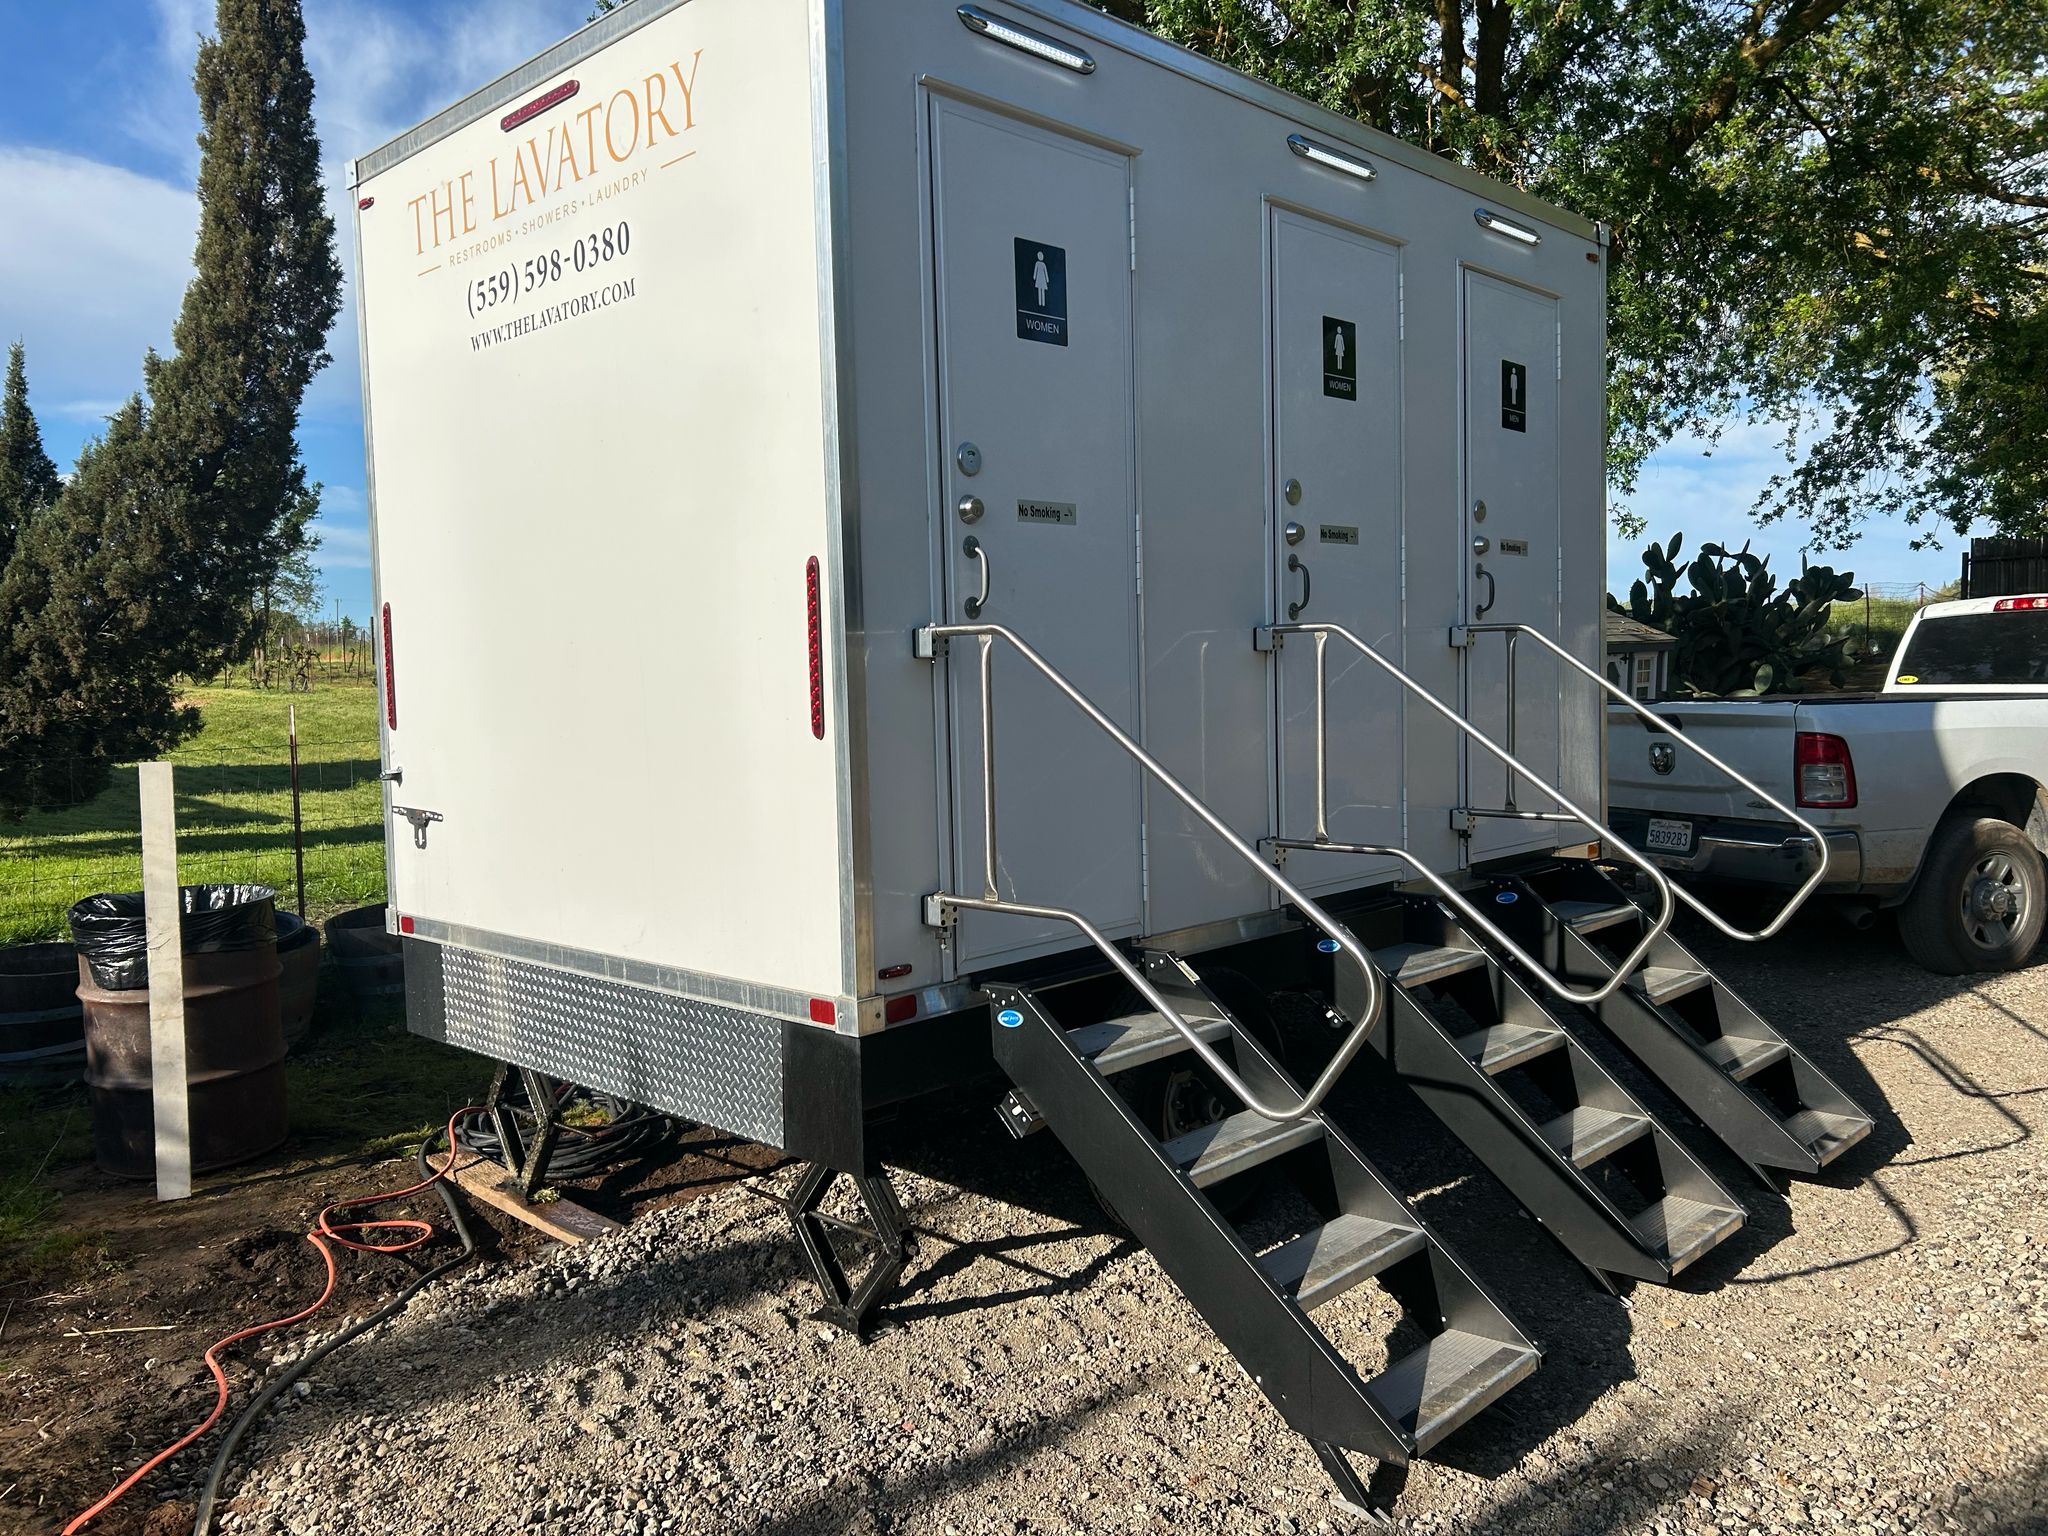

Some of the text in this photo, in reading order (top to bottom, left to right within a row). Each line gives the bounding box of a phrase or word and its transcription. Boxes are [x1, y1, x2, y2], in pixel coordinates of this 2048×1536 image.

[408, 48, 704, 256] THE LAVATORY
[449, 168, 649, 268] RESTROOMS SHOWERS LAUNDRY
[470, 277, 636, 353] WWW.THELAVATORY.COM
[1026, 318, 1060, 334] WOMEN
[1328, 380, 1351, 392] WOMEN
[1018, 504, 1061, 522] No Smoking
[1320, 528, 1348, 542] No Smoking
[1649, 830, 1688, 847] 58392B3
